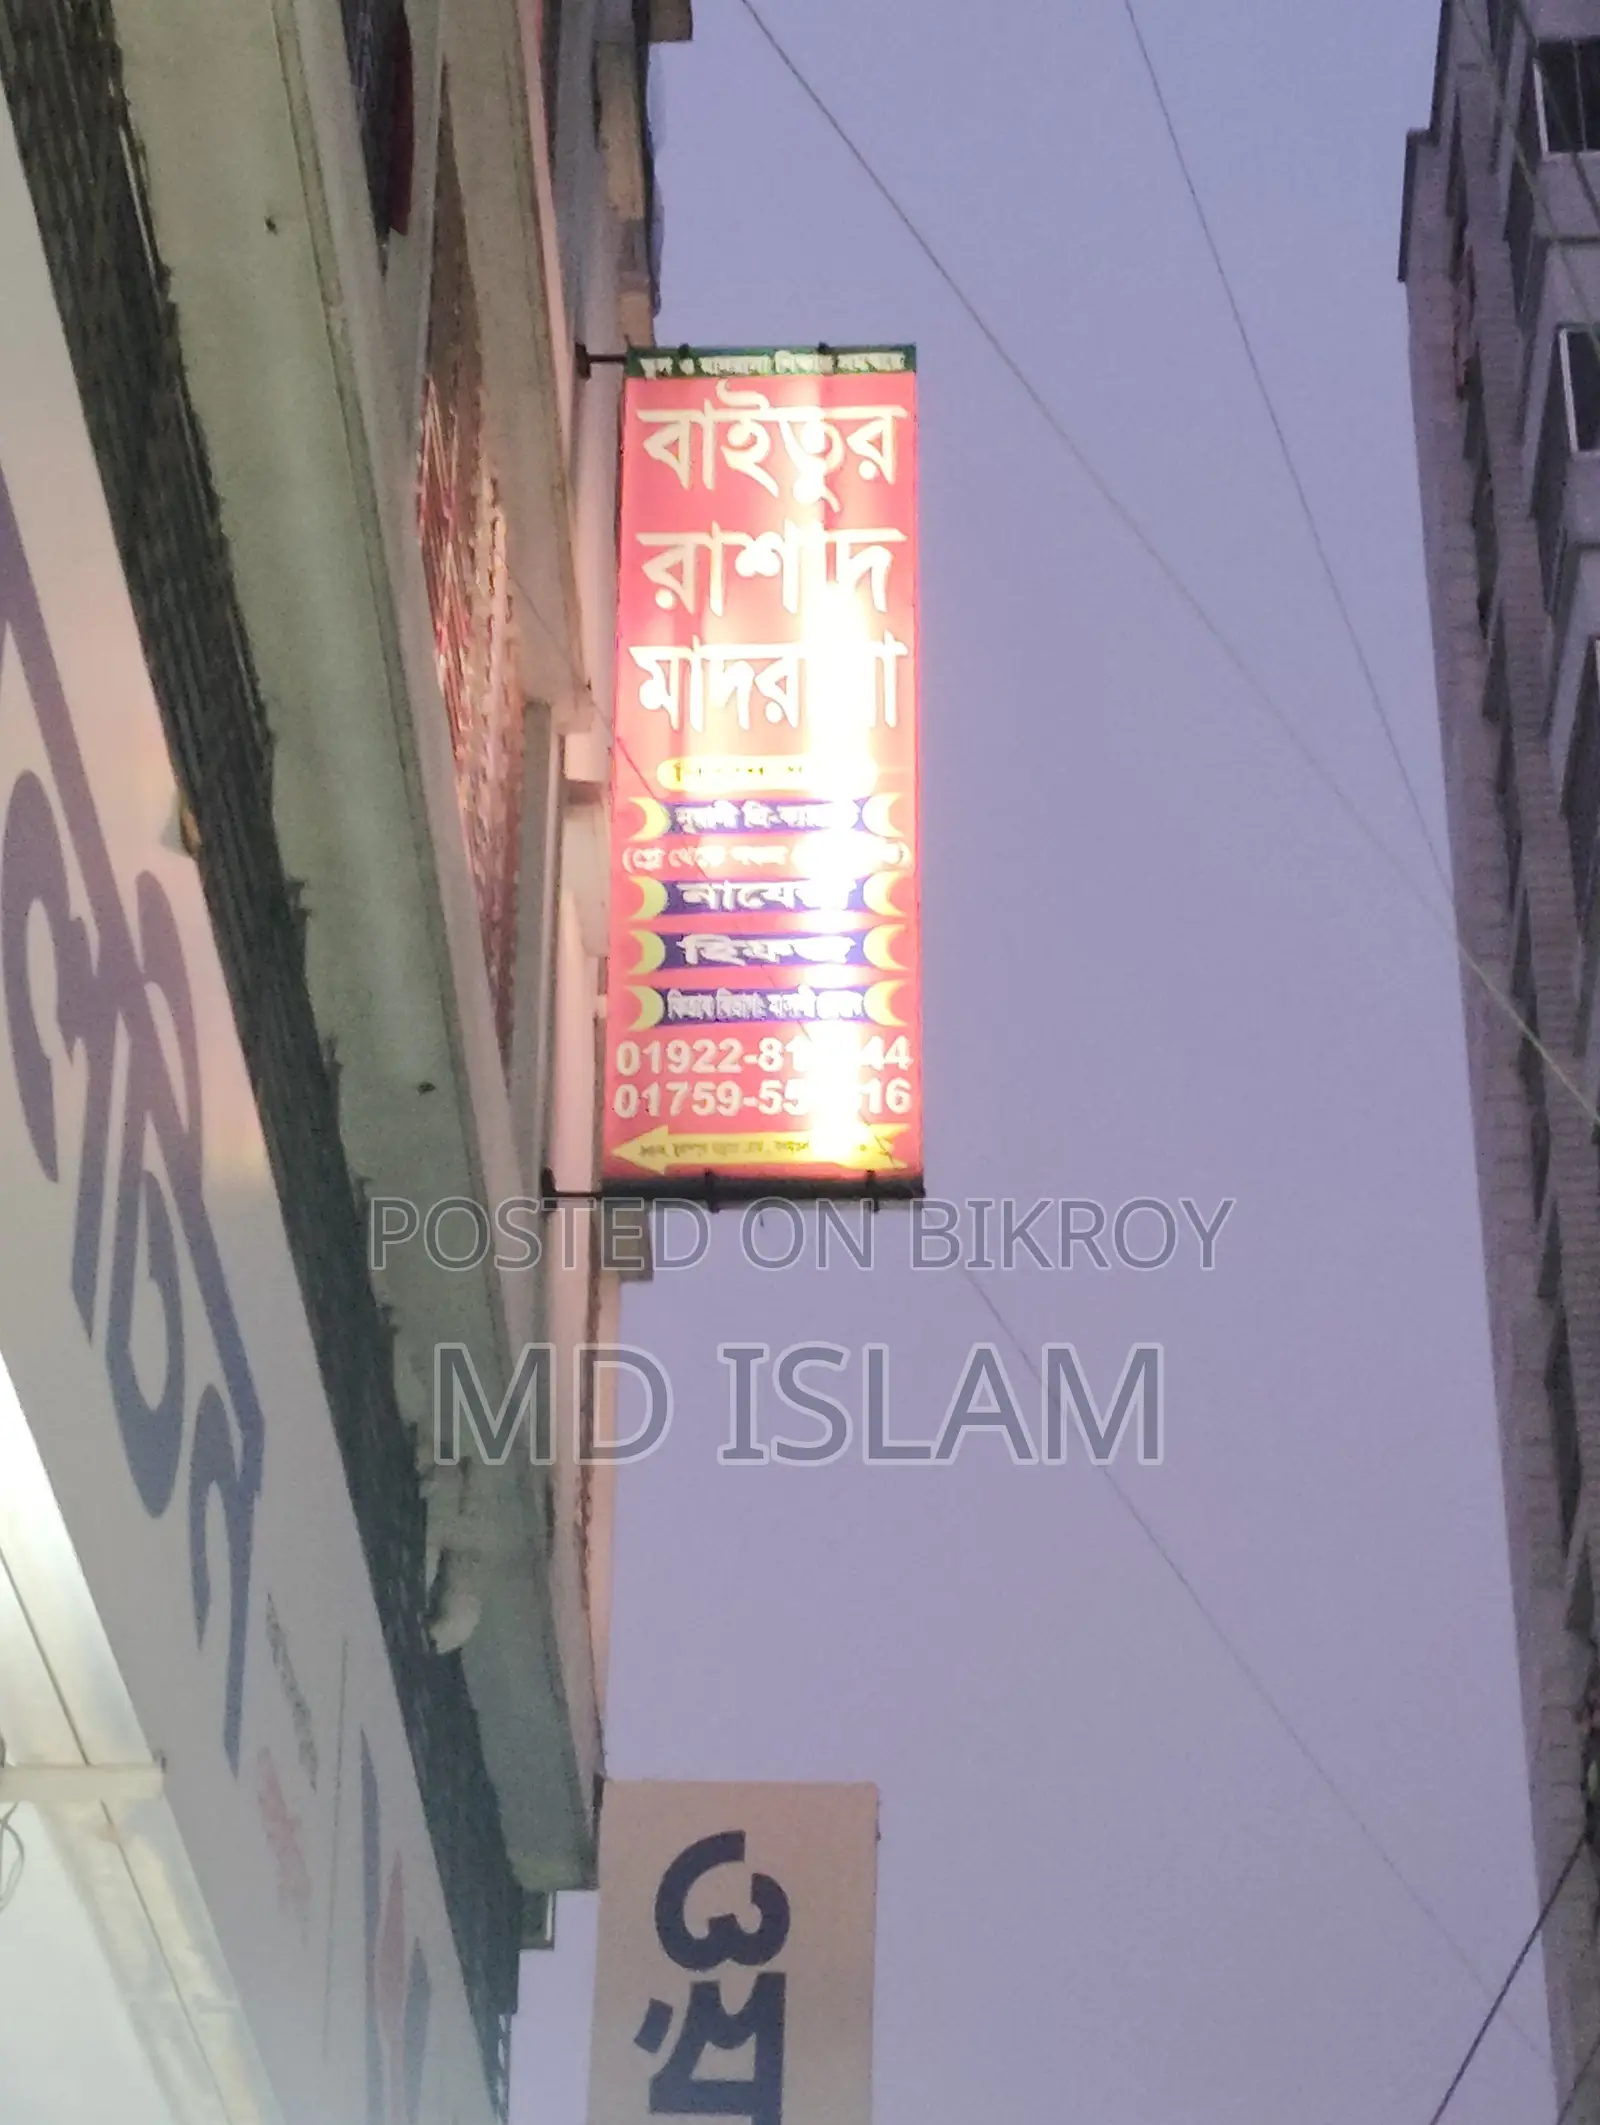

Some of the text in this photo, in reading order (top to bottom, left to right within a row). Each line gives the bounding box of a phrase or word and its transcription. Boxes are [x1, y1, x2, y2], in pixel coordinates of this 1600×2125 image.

[637, 378, 909, 513] বাইতুর
[628, 629, 909, 733] মাদরা
[617, 1036, 914, 1076] 01922-8144
[613, 1078, 913, 1119] 01759-5516
